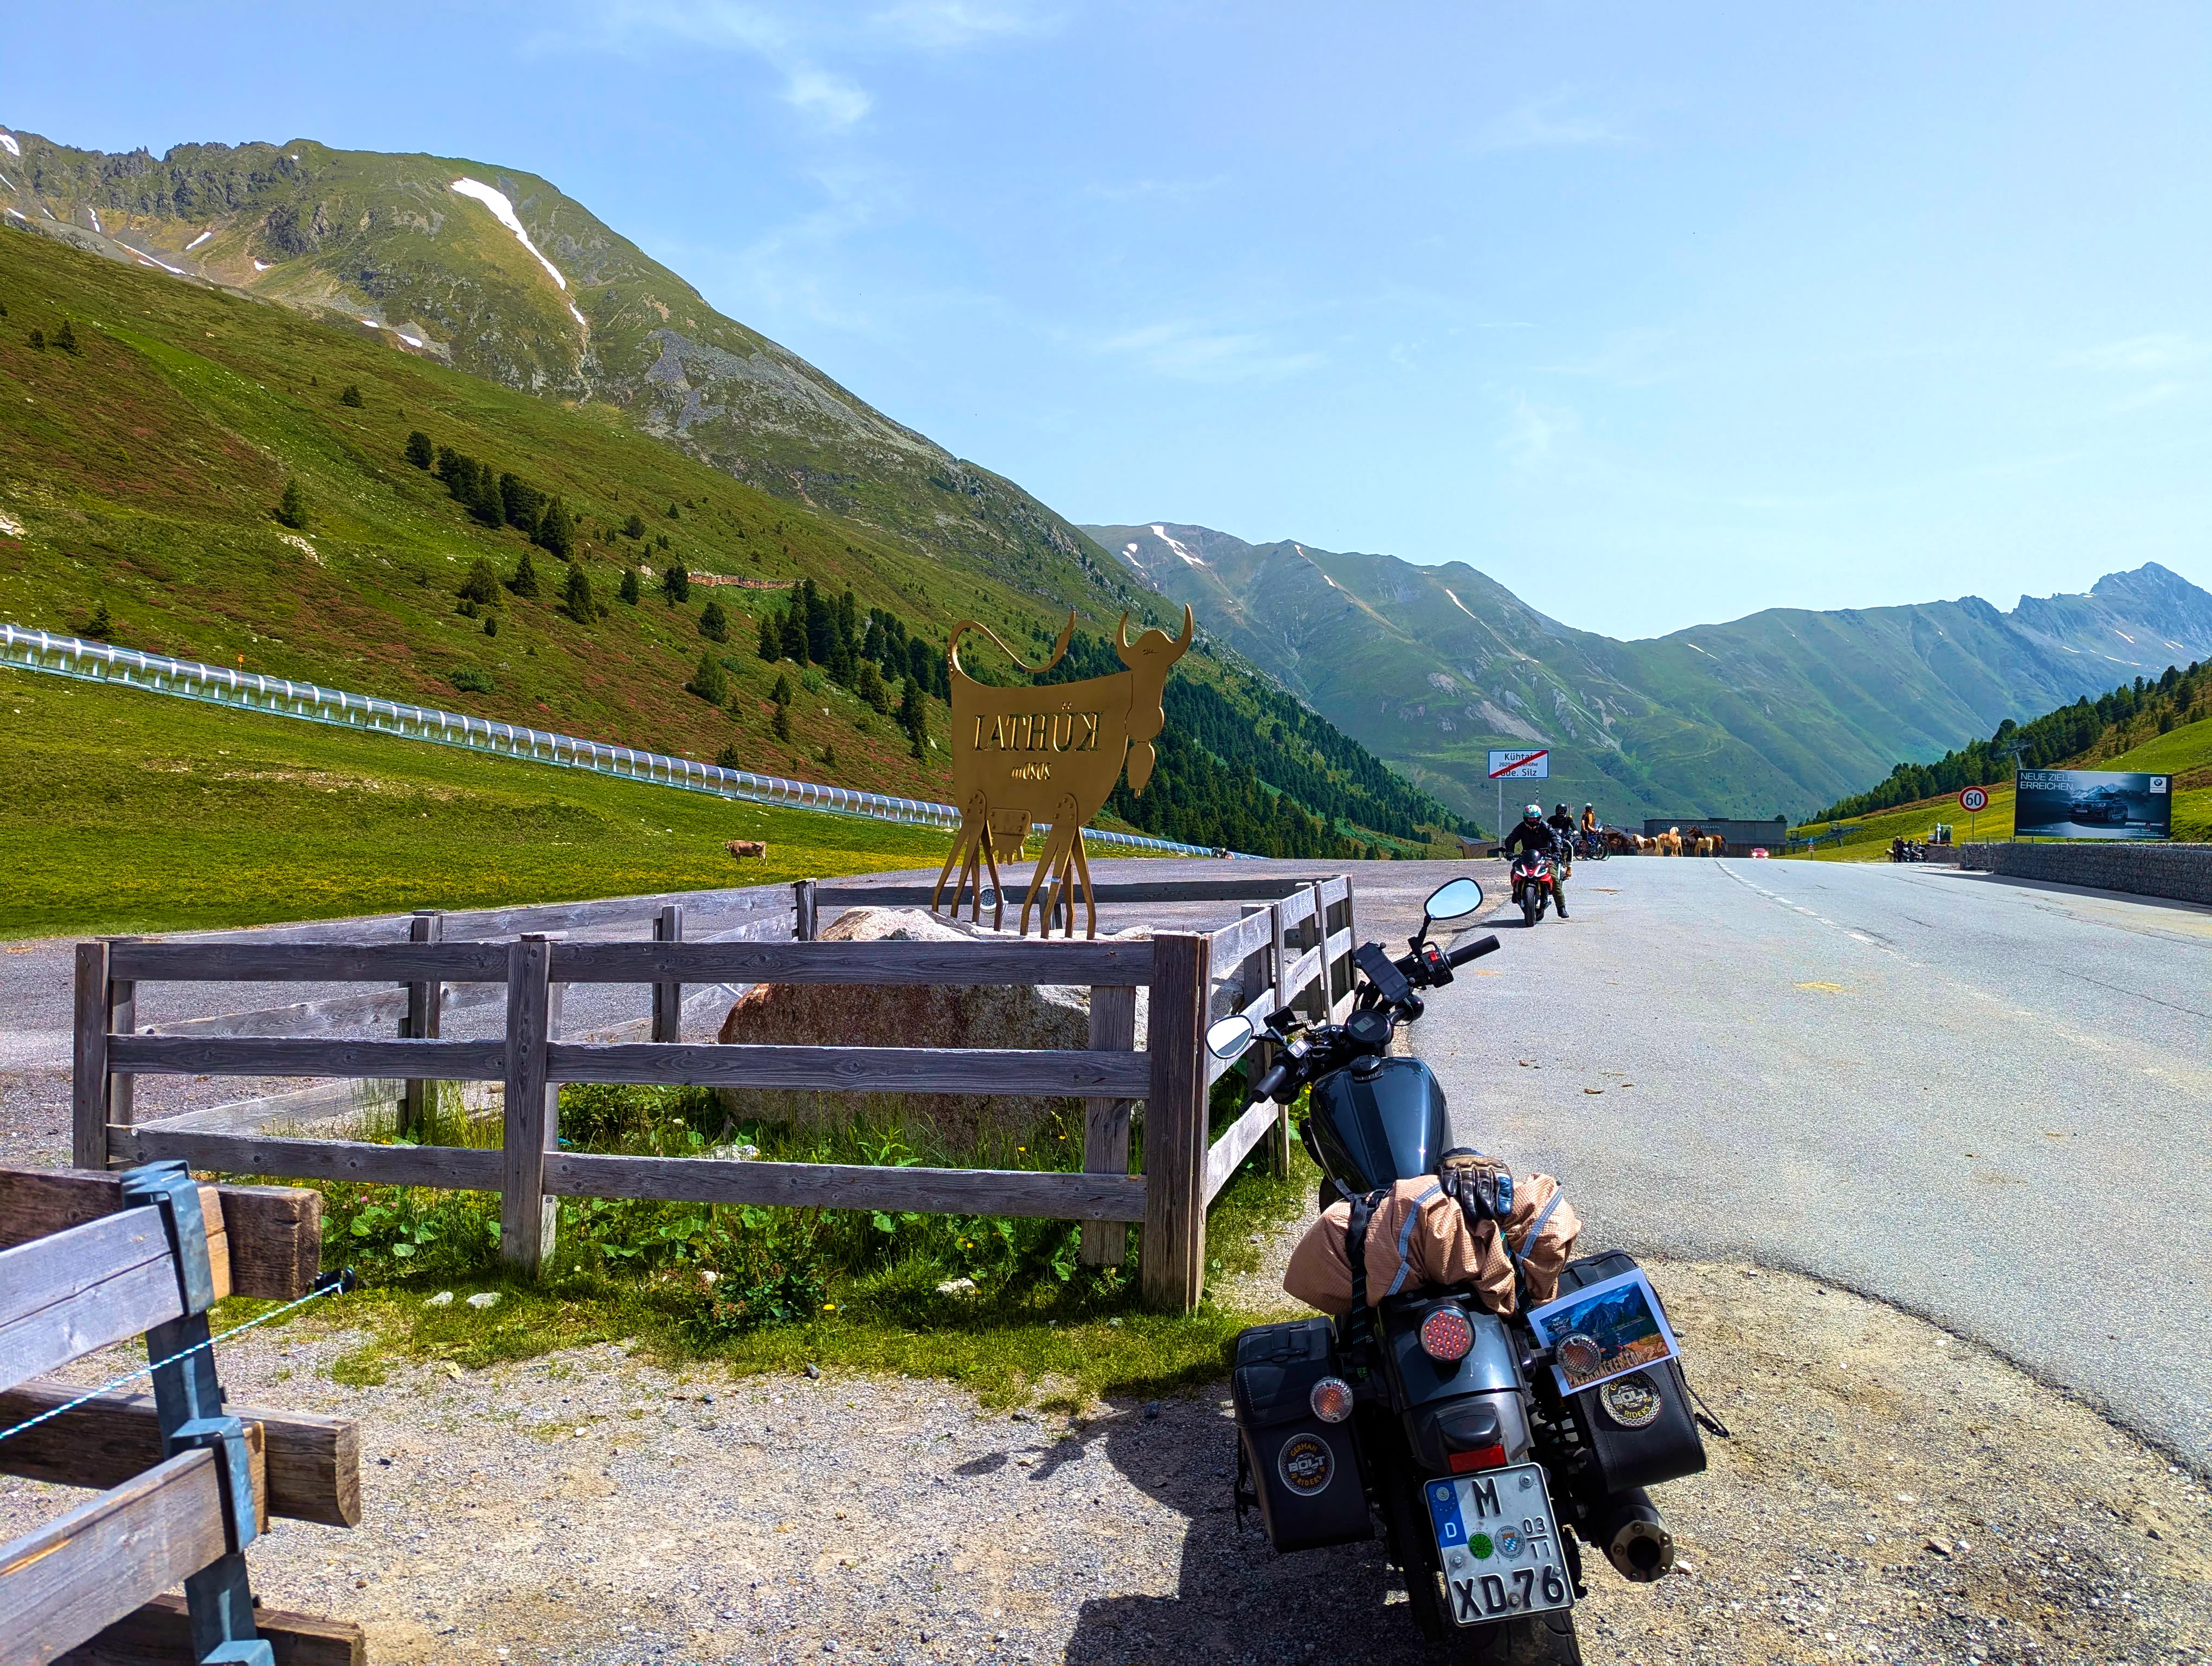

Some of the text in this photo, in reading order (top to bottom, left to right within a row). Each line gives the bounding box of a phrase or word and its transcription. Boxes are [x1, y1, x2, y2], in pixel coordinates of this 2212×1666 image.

[2021, 772, 2074, 782] NEUE ZIELE
[1966, 793, 1982, 806] 60
[1643, 1342, 1669, 1361] 24
[1610, 1376, 1641, 1391] GERMAN
[1611, 1388, 1648, 1405] BOLT
[1624, 1405, 1650, 1418] RIDERS
[1290, 1443, 1318, 1457] GERMAN
[1288, 1456, 1325, 1472] BOLT
[1296, 1475, 1321, 1486] RIDERS
[1472, 1476, 1502, 1517] M
[1444, 1522, 1457, 1538] D
[1523, 1516, 1546, 1534] 03
[1531, 1540, 1551, 1559] 11
[1454, 1564, 1565, 1619] XD 76
